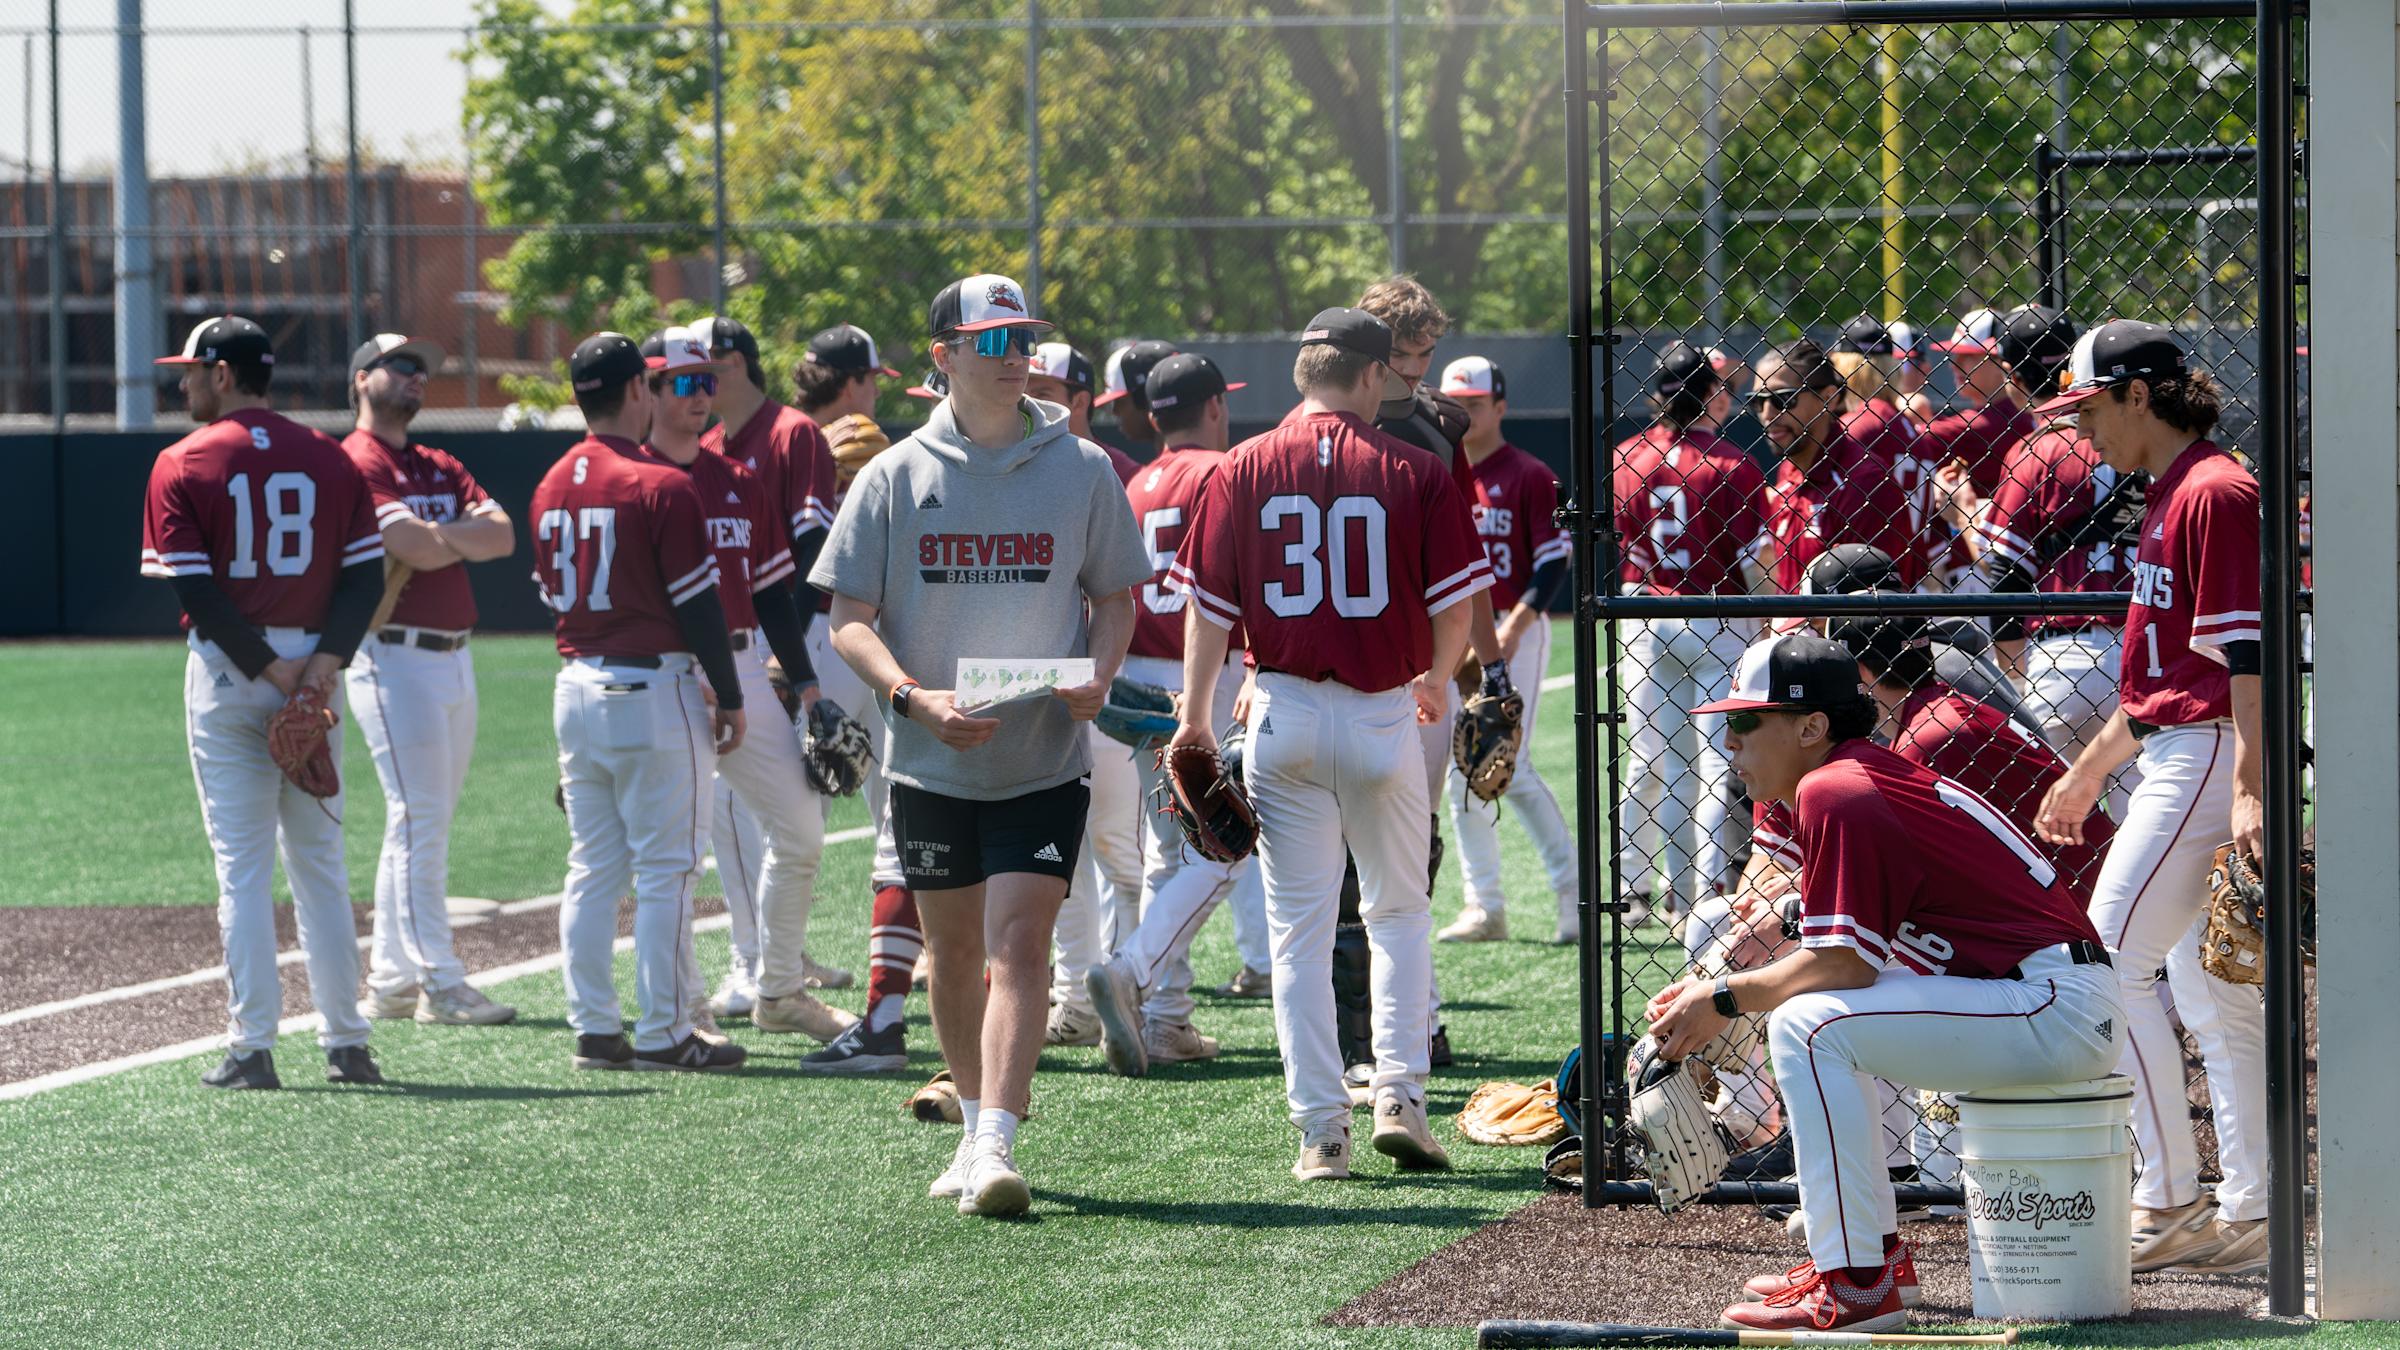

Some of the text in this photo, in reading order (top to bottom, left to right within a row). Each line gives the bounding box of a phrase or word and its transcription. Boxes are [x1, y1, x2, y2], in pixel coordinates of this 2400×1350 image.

[250, 426, 271, 450] S
[573, 456, 589, 484] S
[227, 472, 316, 578] 18
[1650, 485, 1691, 569] 2
[538, 507, 617, 613] 37
[919, 532, 1055, 566] STEVENS
[1260, 494, 1390, 618] 30
[946, 570, 1026, 583] BASEBALL
[2144, 623, 2163, 678] 1
[906, 840, 951, 853] STEVENS
[919, 850, 936, 868] S
[906, 866, 950, 877] ATHLETICS
[1890, 920, 1955, 976] 16
[1970, 1188, 2015, 1222] Deck
[2016, 1190, 2096, 1230] Sports
[1995, 1235, 2027, 1243] SOFTBALL
[2028, 1235, 2071, 1243] EQUIPMENT
[2005, 1266, 2040, 1274] 365-6171
